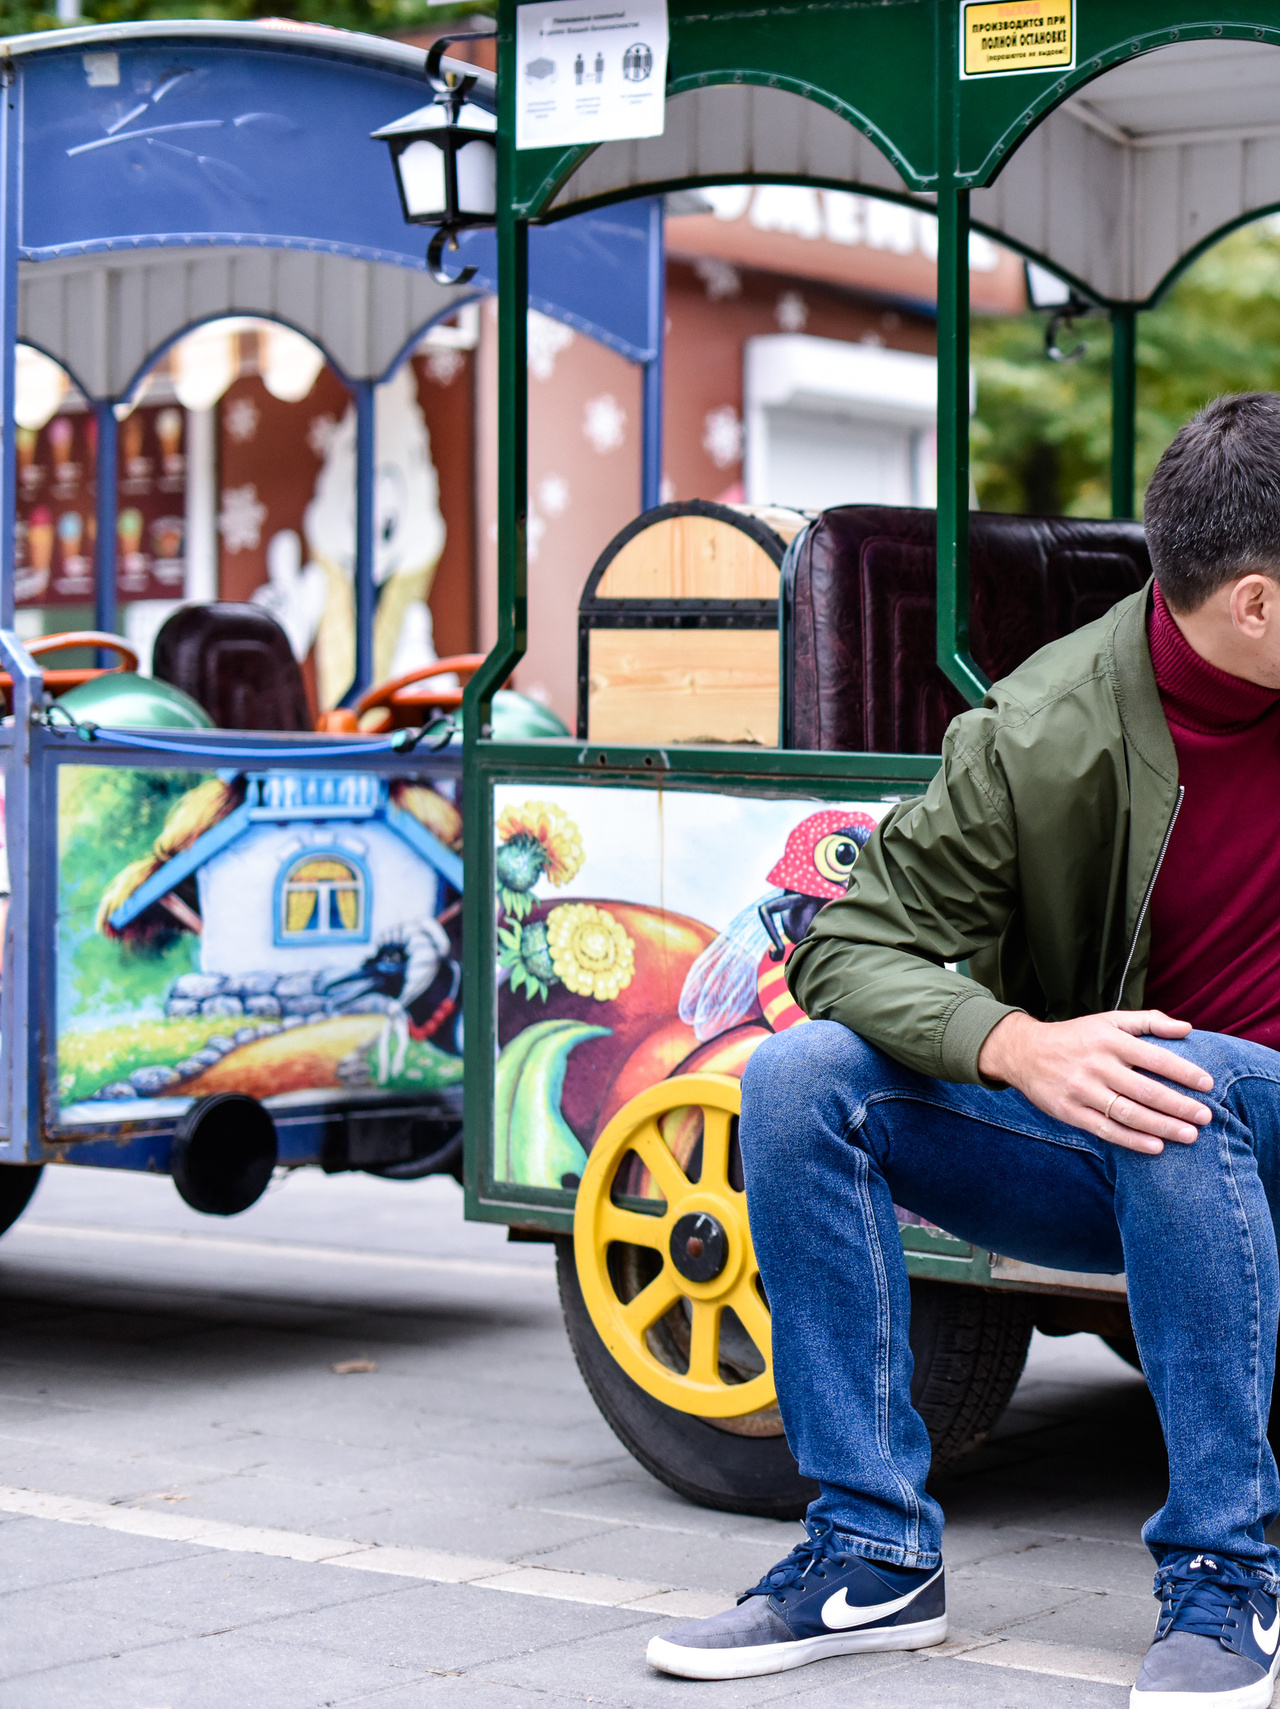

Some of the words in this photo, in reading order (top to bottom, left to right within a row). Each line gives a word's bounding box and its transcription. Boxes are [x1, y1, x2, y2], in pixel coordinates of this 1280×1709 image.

[972, 17, 1044, 33] ПРОИЗВОДИТСЯ
[1047, 15, 1066, 26] ПРИ
[981, 31, 1017, 50] ПОЛНОЙ
[1020, 29, 1067, 46] ОСТАНОВКЕ
